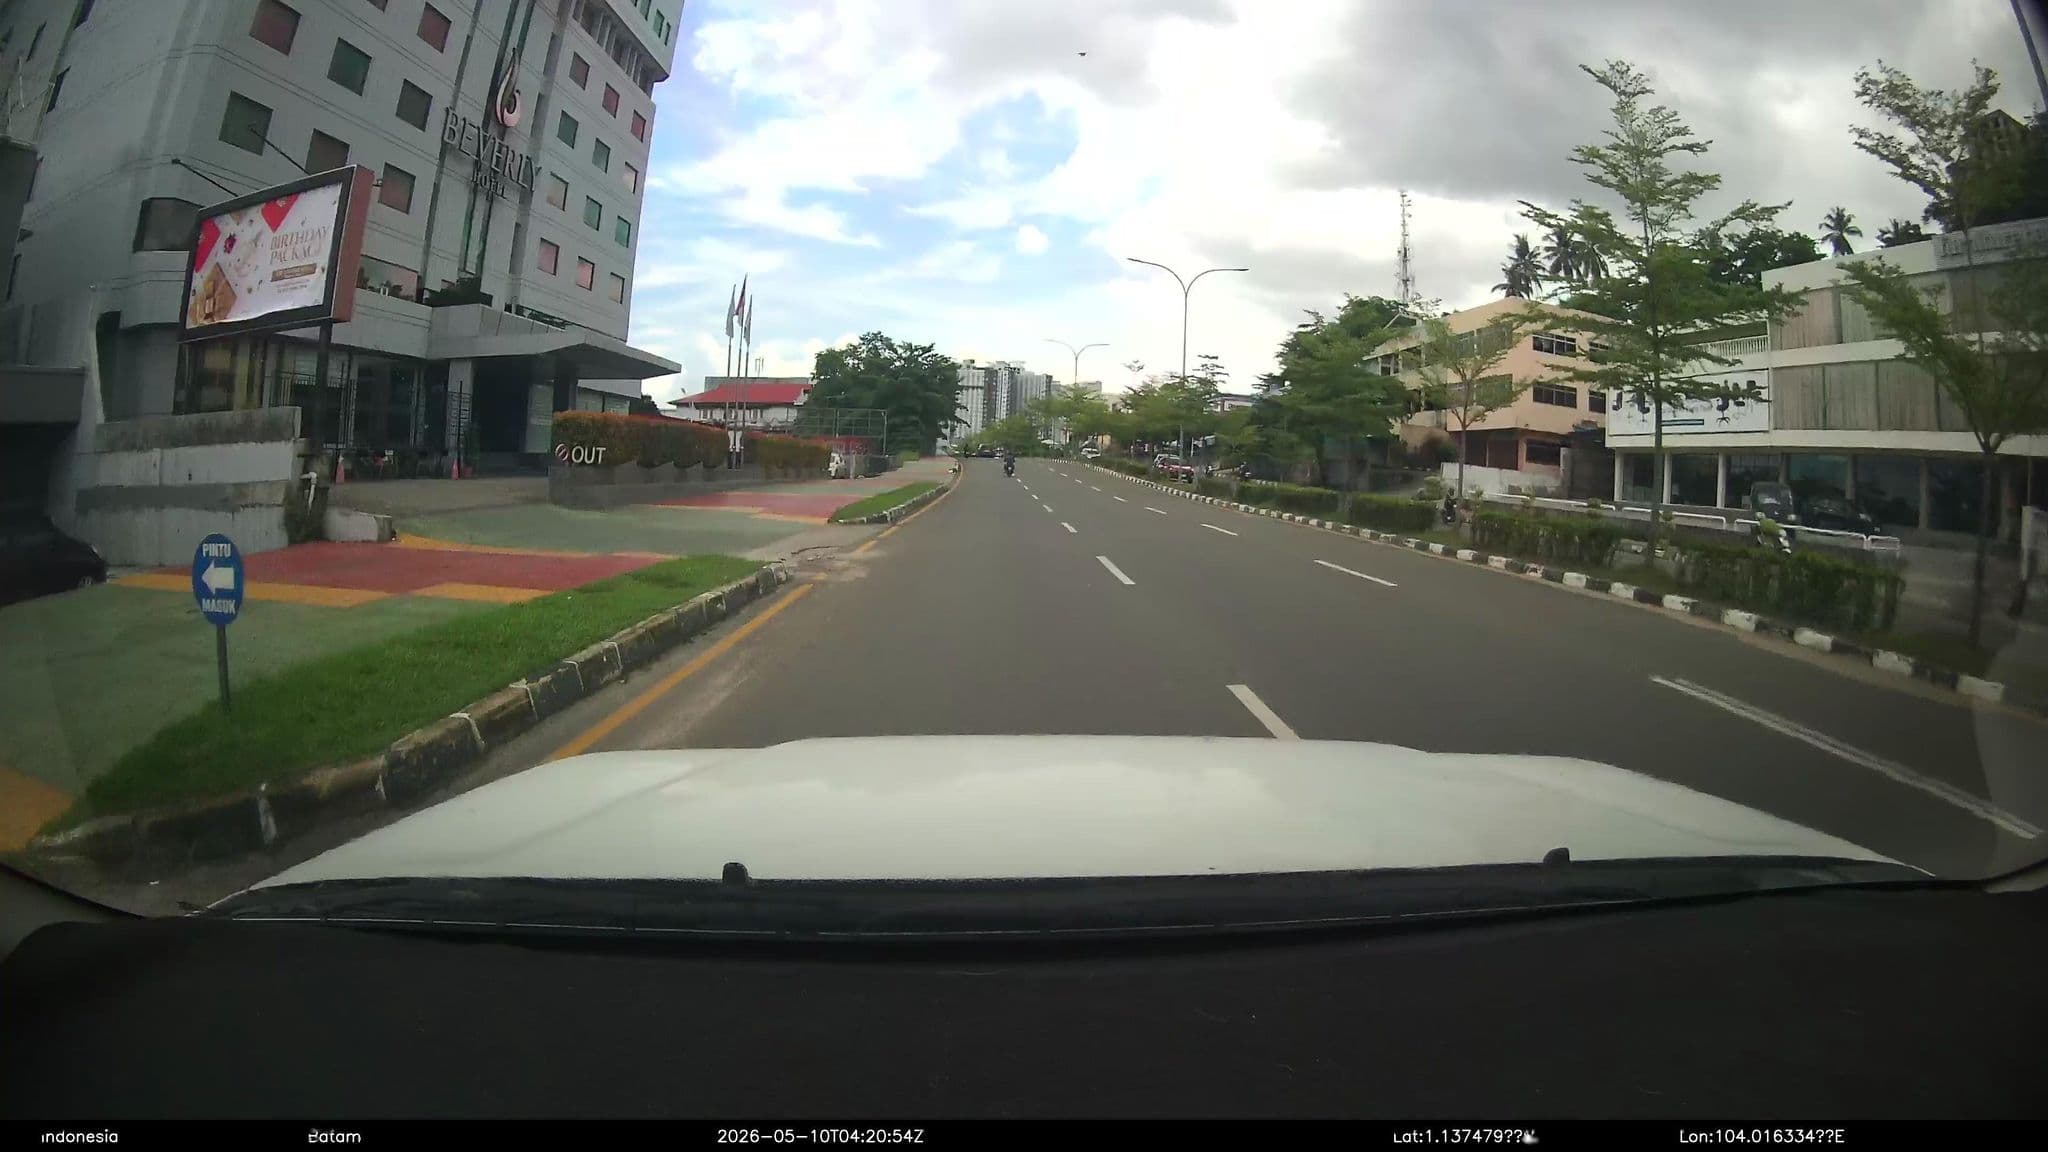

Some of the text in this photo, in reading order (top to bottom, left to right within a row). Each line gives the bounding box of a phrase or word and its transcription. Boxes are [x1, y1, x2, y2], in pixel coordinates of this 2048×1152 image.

[443, 106, 542, 192] BEVERLY
[471, 168, 508, 200] HOTEL
[270, 225, 330, 250] BIRTHDAY
[571, 445, 607, 464] OUT
[202, 543, 231, 557] PINTU
[201, 598, 236, 615] MASUK
